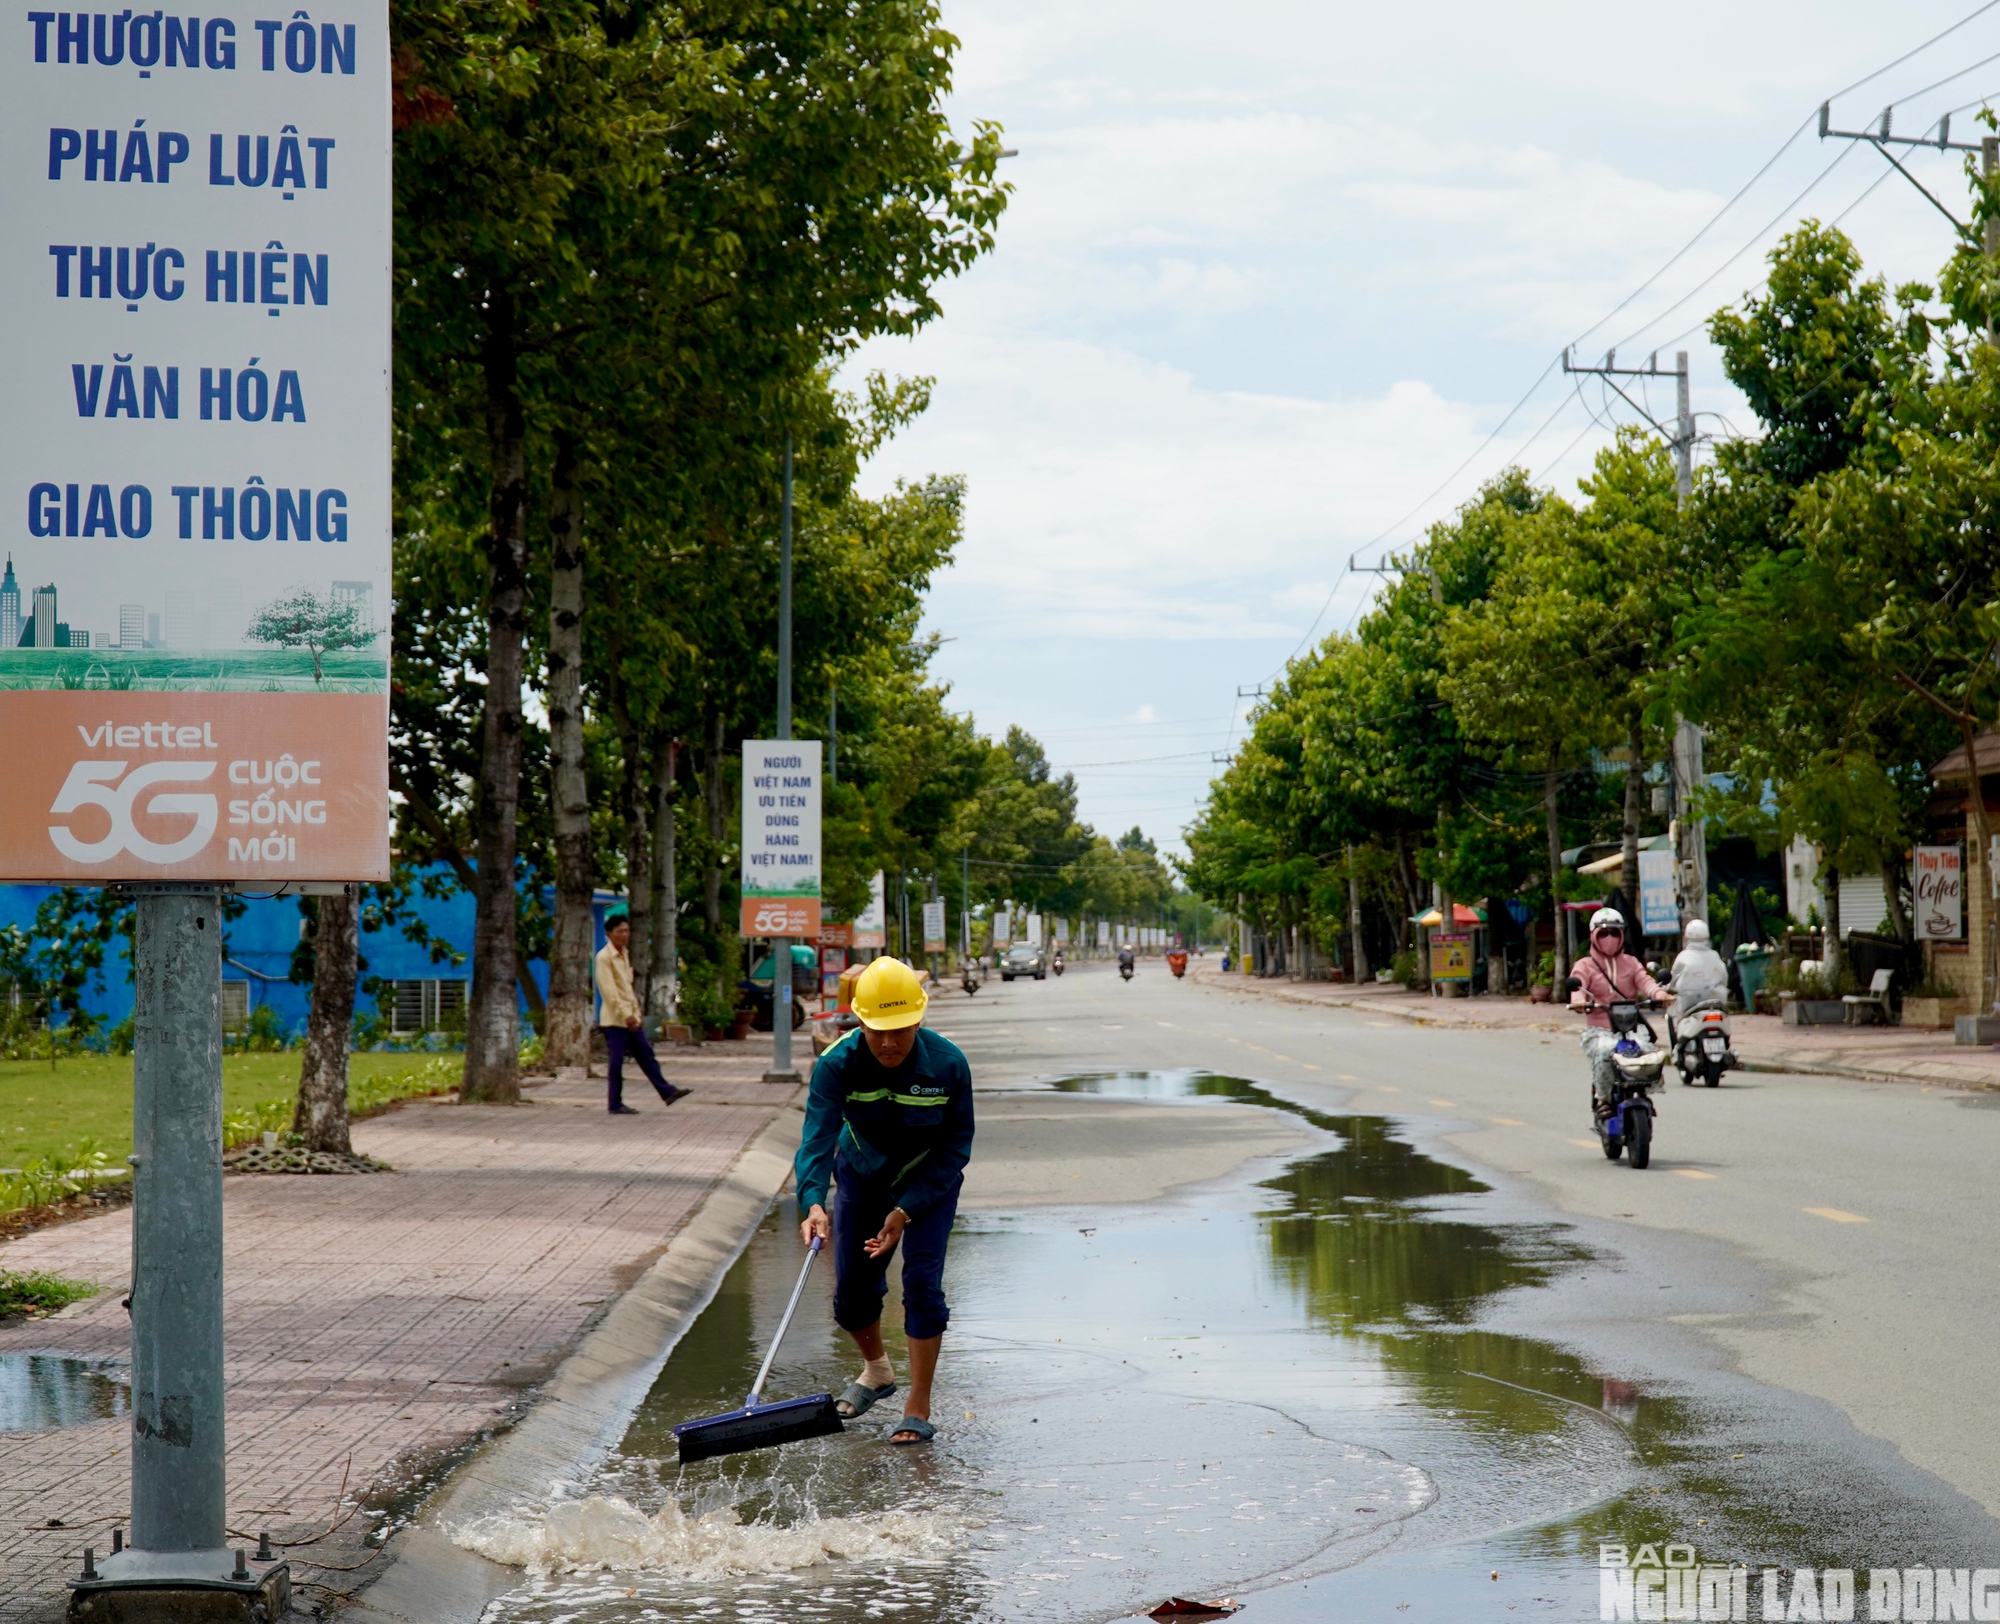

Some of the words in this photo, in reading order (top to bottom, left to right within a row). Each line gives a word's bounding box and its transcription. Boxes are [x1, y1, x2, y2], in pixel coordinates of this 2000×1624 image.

[28, 10, 236, 78] THƯỢNG
[255, 11, 356, 74] TÔN
[48, 119, 189, 183] PHÁP
[209, 125, 335, 200] LUẬT
[49, 242, 185, 312] THỰC
[205, 240, 328, 316] HIỆN
[72, 353, 179, 419] VĂN
[200, 357, 306, 422] HÓA
[28, 482, 152, 538] GIAO
[172, 475, 348, 542] THÔNG
[78, 721, 218, 748] viettel
[228, 753, 321, 789] CUỘC
[764, 755, 802, 769] NGƯỜI
[753, 774, 779, 790] VIỆT
[783, 776, 811, 788] NAM
[48, 760, 218, 864] 5G
[228, 788, 327, 824] SỐNG
[759, 795, 775, 807] ƯU
[779, 793, 806, 807] TIÊN
[765, 813, 799, 826] DÙNG
[228, 830, 296, 861] MỚI
[765, 832, 799, 846] HÀNG
[751, 852, 776, 867] VIỆT
[780, 854, 813, 865] NAM!
[1918, 873, 1959, 905] Coffee
[754, 911, 787, 932] 5G
[879, 1000, 907, 1009] CENTRAL
